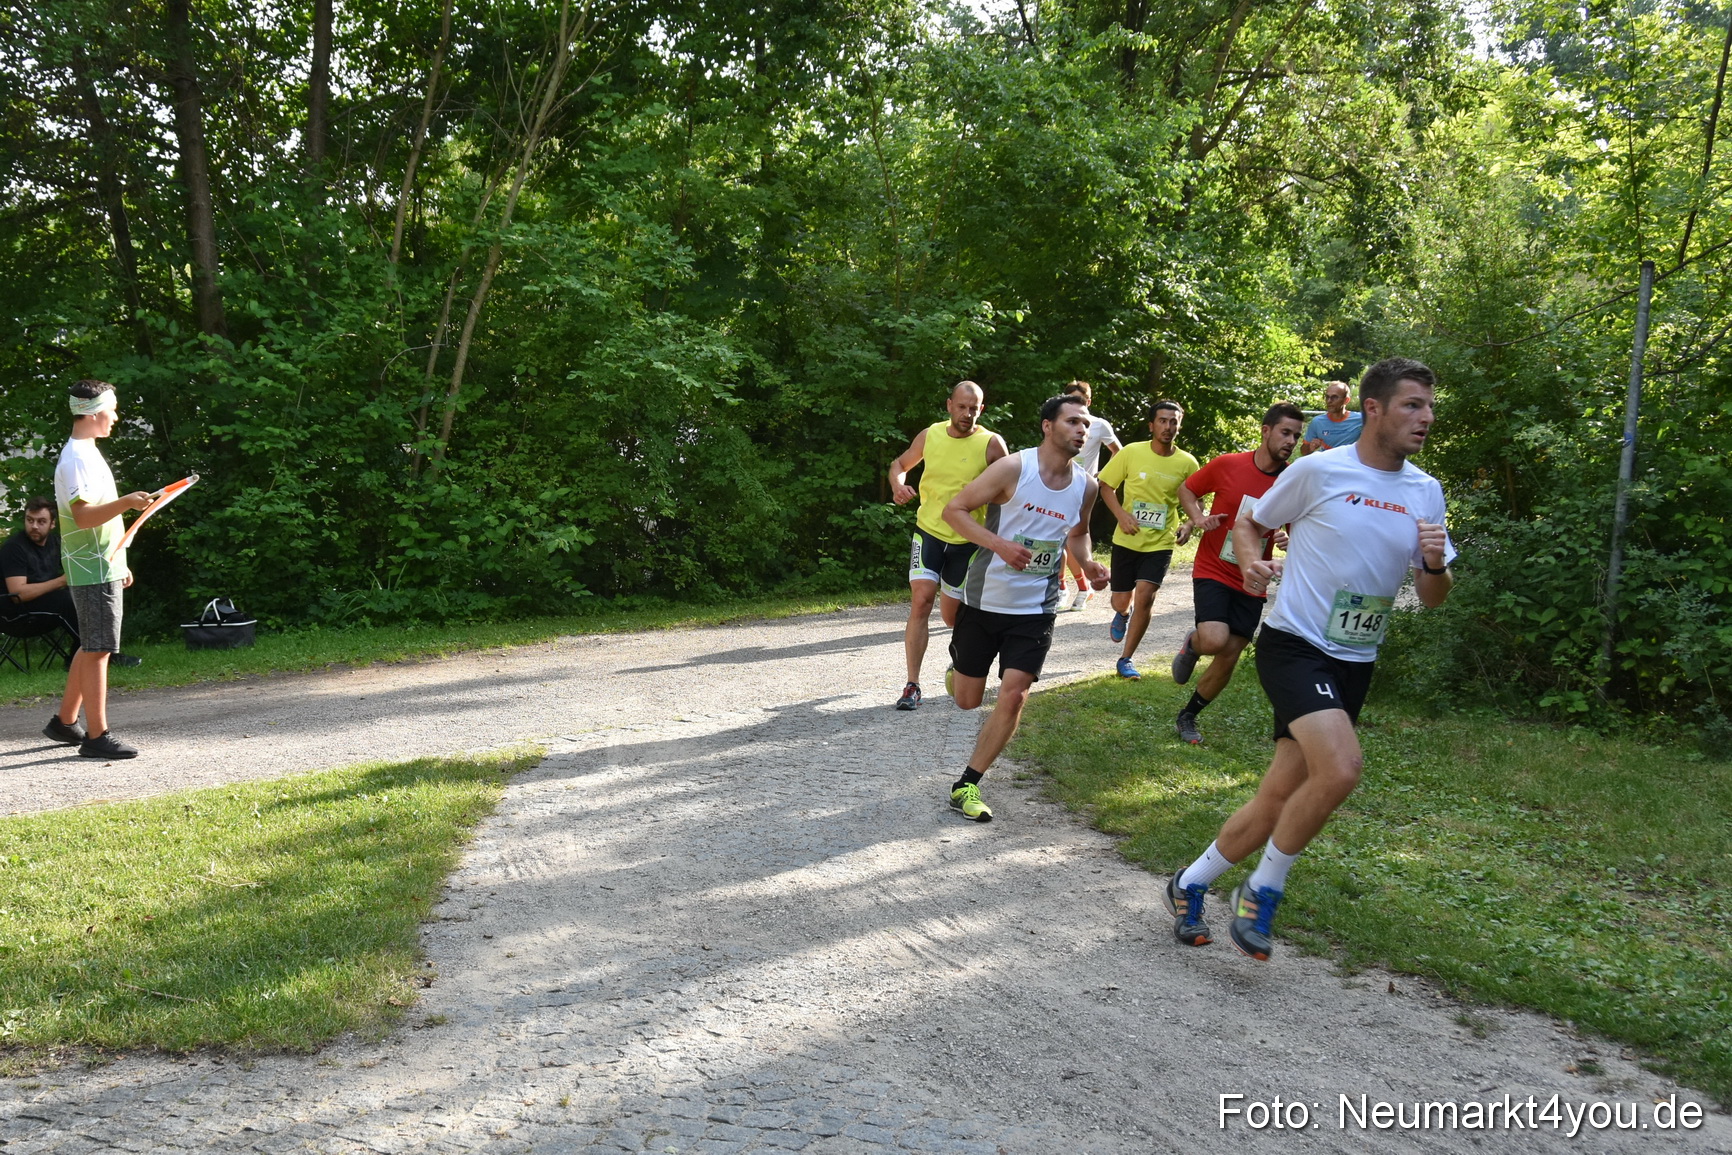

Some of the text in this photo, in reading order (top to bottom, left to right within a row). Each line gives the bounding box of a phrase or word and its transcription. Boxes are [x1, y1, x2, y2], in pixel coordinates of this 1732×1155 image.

[1036, 507, 1066, 521] KLEBL
[1364, 499, 1409, 515] KLEBL
[1135, 510, 1162, 522] 1277
[1033, 552, 1051, 565] 49
[1340, 610, 1383, 632] 1148
